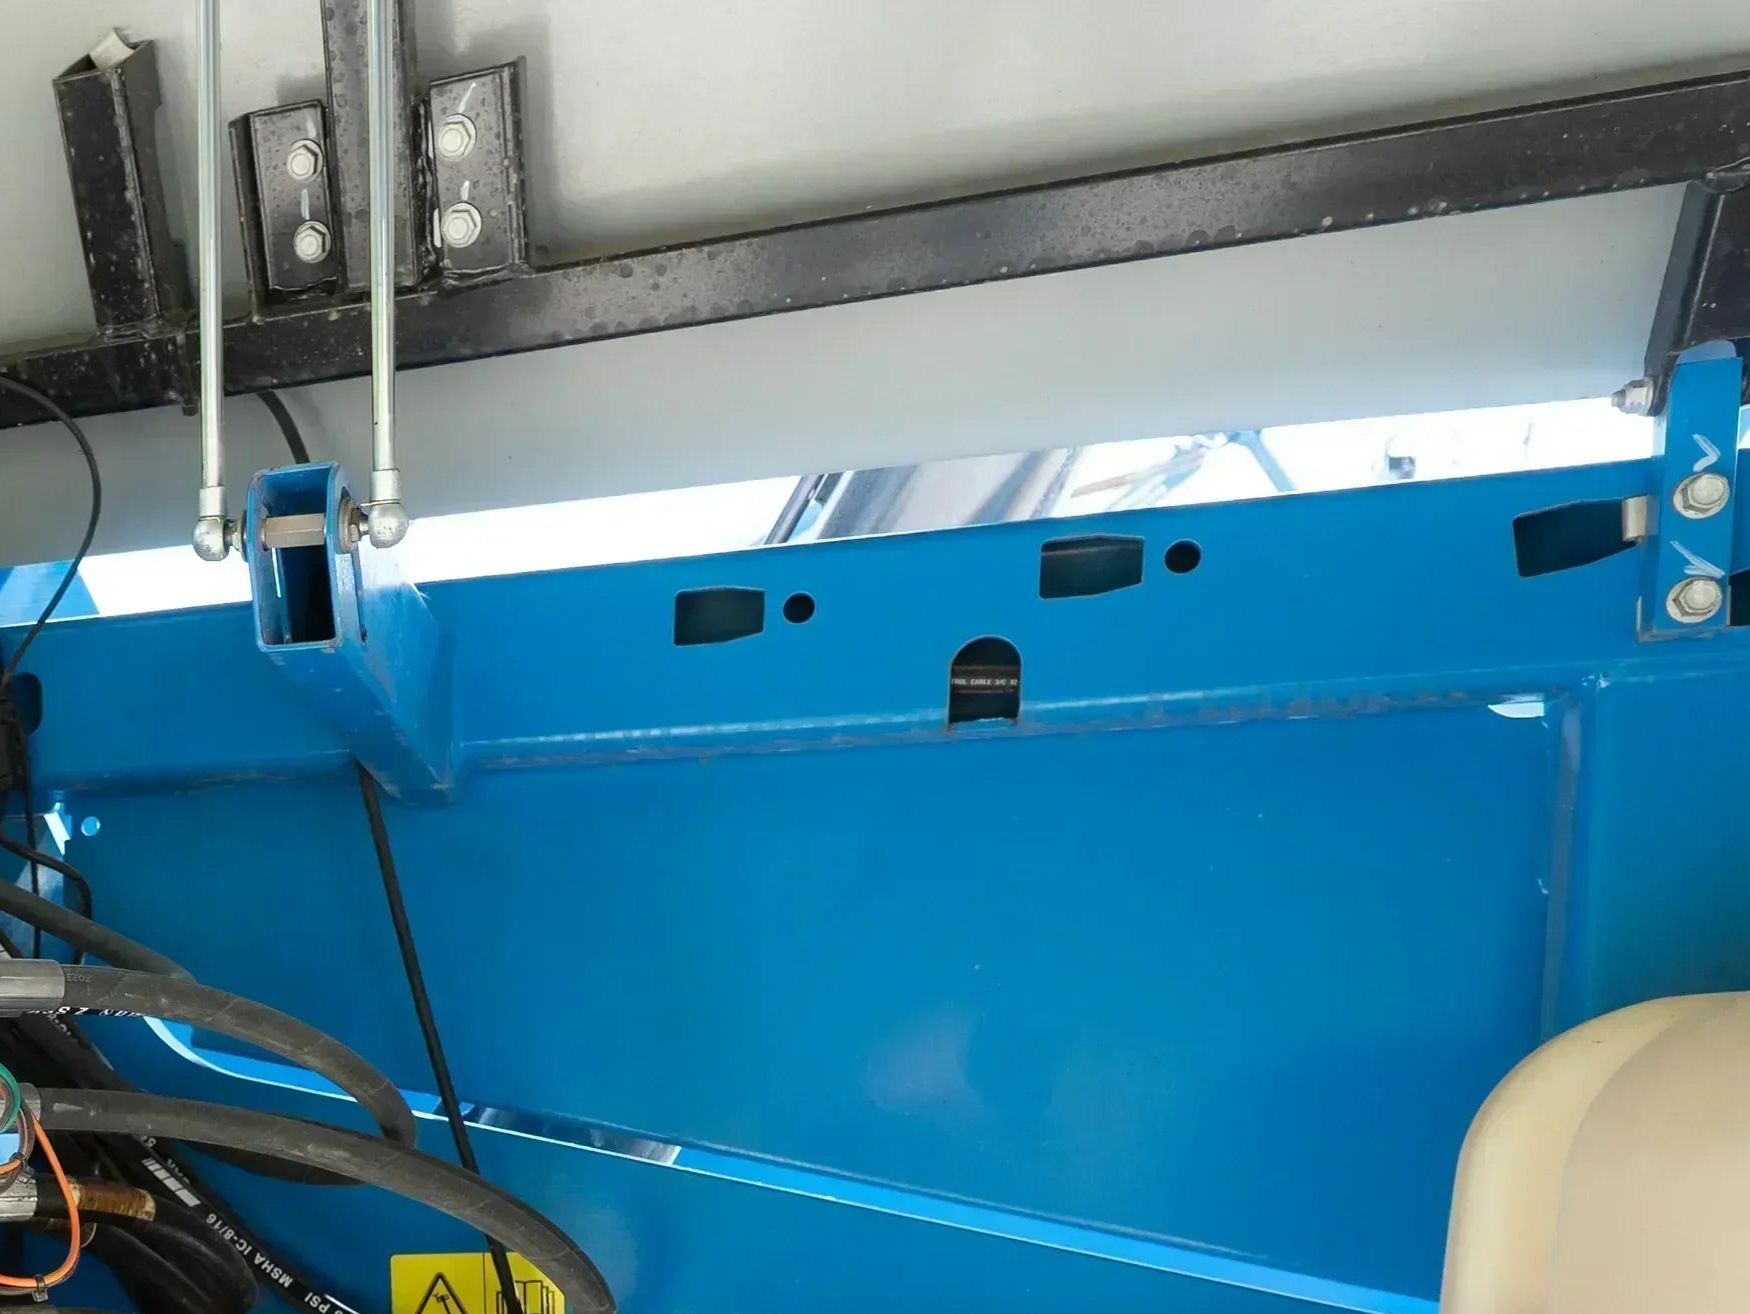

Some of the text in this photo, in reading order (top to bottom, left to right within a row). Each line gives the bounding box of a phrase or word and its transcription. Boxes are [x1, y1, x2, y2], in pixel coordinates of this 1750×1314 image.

[206, 1213, 253, 1256] IC-8/16
[254, 1252, 294, 1288] MSHA
[304, 1292, 331, 1314] PSI
